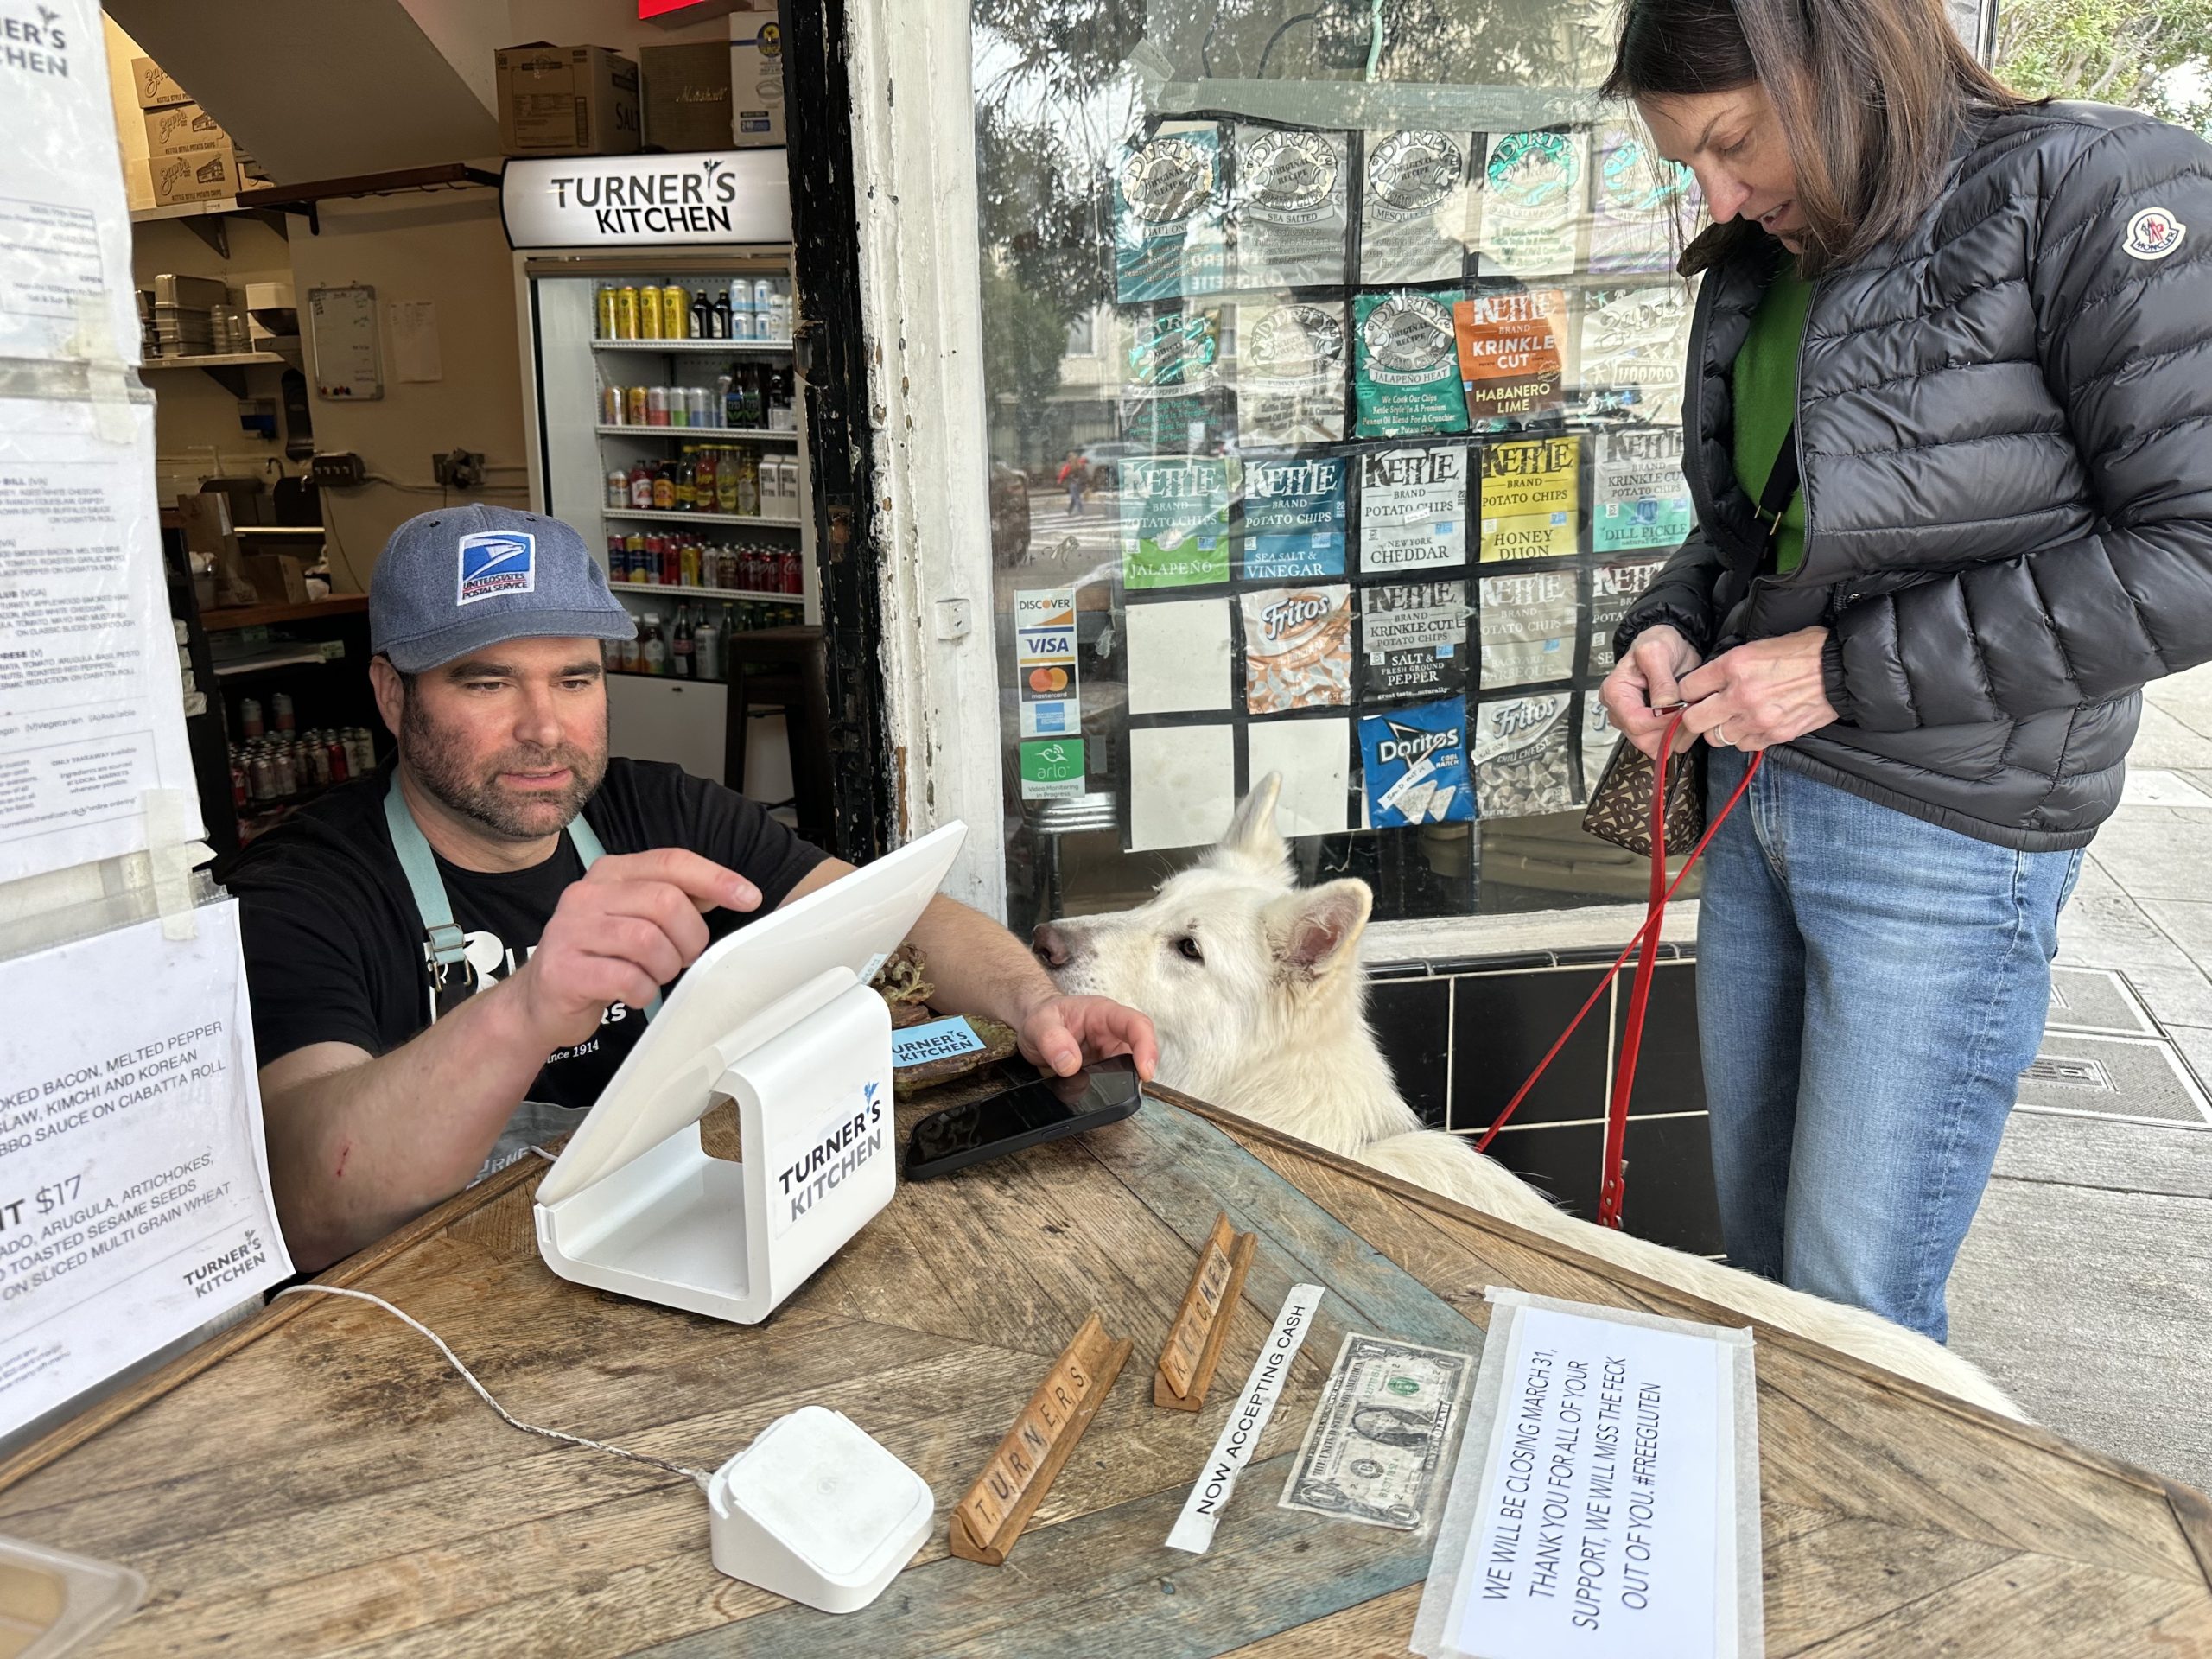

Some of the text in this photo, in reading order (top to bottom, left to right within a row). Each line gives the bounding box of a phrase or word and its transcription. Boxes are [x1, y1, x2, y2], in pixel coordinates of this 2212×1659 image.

[0, 16, 67, 50] ER'S
[0, 45, 68, 79] HEN
[1250, 130, 1333, 166] DIRTY
[551, 170, 736, 207] TURNER'S
[595, 206, 733, 234] KITCHEN
[1268, 213, 1318, 223] SEA SALTED
[2136, 232, 2176, 251] MONCLER
[1373, 296, 1450, 329] DIRTY
[1499, 324, 1530, 335] BRAND
[1395, 332, 1427, 347] RECIPE
[1472, 334, 1555, 357] KRINKLE
[1497, 353, 1529, 370] CUT
[1374, 368, 1448, 384] JALAPEÑO HEAT
[1382, 393, 1438, 404] We Cook Our Chips
[1475, 383, 1551, 403] HABANERO
[1421, 403, 1446, 413] Premium
[1497, 398, 1530, 414] LIME
[1362, 448, 1459, 489] KETTLE
[1482, 442, 1573, 479] KETTLE
[1632, 461, 1666, 473] BRAND
[1119, 460, 1221, 500] KETTLE
[1244, 459, 1337, 499] KETTLE
[1507, 478, 1543, 489] BRAND
[1607, 472, 1662, 487] KRINKLE
[1394, 488, 1426, 499] BRAND
[1482, 489, 1568, 507] POTATO CHIPS
[1153, 501, 1189, 512] BRAND
[1272, 499, 1308, 510] BRAND
[1125, 514, 1217, 530] POTATO CHIPS
[1245, 512, 1332, 529] POTATO CHIPS
[1494, 529, 1554, 547] HONEY
[1605, 523, 1687, 542] DILL PICKLE
[1388, 537, 1433, 549] NEW YORK
[1255, 551, 1318, 563] SEA SALT &
[1370, 545, 1450, 565] CHEDDAR
[1128, 559, 1213, 580] JALAPEÑO
[1247, 563, 1325, 579] VINEGAR
[463, 573, 525, 589] UNITED STATES
[462, 582, 528, 600] POSTAL SERVICE
[1363, 582, 1457, 614] KETTLE
[1019, 598, 1071, 611] DISCOVER
[1260, 595, 1330, 641] Fritos
[1395, 612, 1428, 623] BRAND
[1370, 621, 1427, 638] KRINKLE
[1026, 637, 1070, 654] VISA
[1376, 632, 1448, 648] POTATO CHIPS
[1391, 652, 1434, 666] SALT &
[1382, 662, 1445, 676] FRESH GROUND
[1387, 672, 1440, 687] PEPPER
[1031, 691, 1068, 700] mastercard
[1377, 690, 1395, 701] great
[1491, 696, 1556, 739] Fritos
[1380, 728, 1459, 763] Doritos
[1497, 753, 1517, 763] CHILI
[1519, 735, 1552, 760] CHEESE
[1038, 765, 1066, 779] arlo
[1044, 791, 1071, 799] Progress
[1046, 783, 1079, 793] Monitoring
[547, 1039, 600, 1064] ince 1914
[892, 1028, 968, 1056] URNER'S
[899, 1039, 975, 1062] KITCHEN
[42, 1020, 223, 1096] BACON, MELTED PEPPER
[47, 1048, 198, 1116] KIMCHI AND KOREAN
[0, 1058, 226, 1157] BBQ SAUCE ON CIABATTA ROLL
[779, 1097, 881, 1196] TURNER'S
[791, 1128, 881, 1223] KITCHEN
[35, 1173, 82, 1215] $17
[41, 1198, 119, 1239] ARUGULA,
[121, 1153, 215, 1204] ARTICHOKES,
[10, 1179, 198, 1275] TOASTED SESAME SEEDS
[3, 1181, 232, 1301] ON SLICED MULTI GRAIN WHEAT
[182, 1236, 263, 1286] TURNER'S
[194, 1252, 267, 1298] KITCHEN
[1196, 1305, 1306, 1516] NOW ACCEPTING CASH
[1482, 1349, 1558, 1599] WE WILL BE CLOSING MARCH 31,
[1529, 1360, 1589, 1598] THANK YOU FOR ALL OF YOUR
[1572, 1356, 1626, 1630] SUPPORT, WE WILL MISS THE FECK
[1621, 1382, 1661, 1610] OUT OF YOU. #FREEGLUTEN
